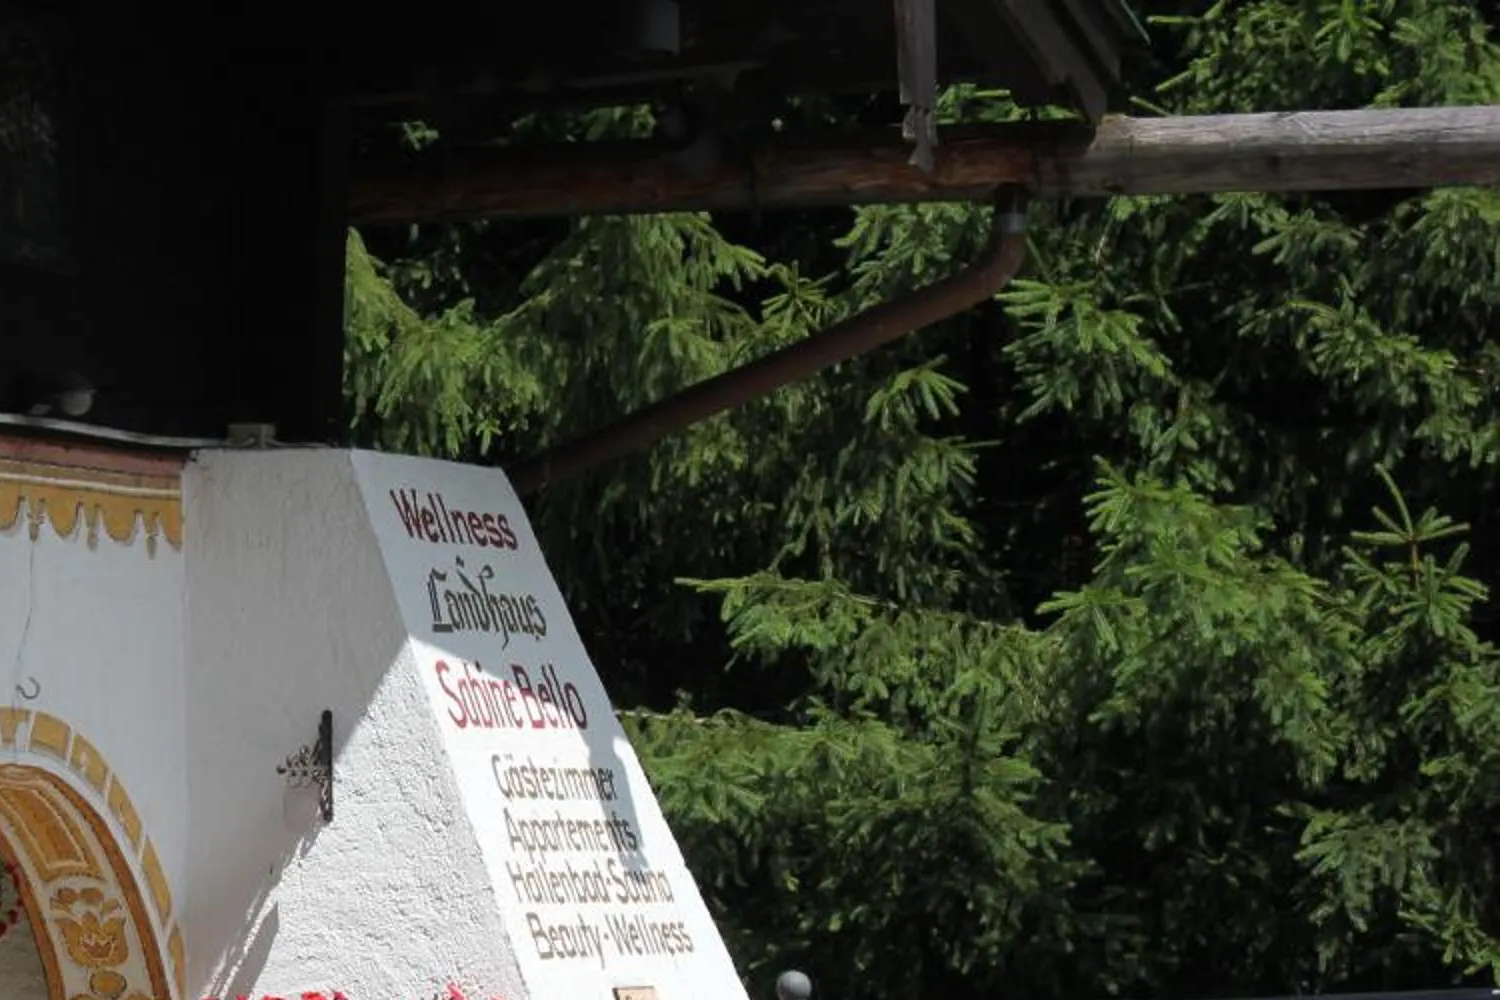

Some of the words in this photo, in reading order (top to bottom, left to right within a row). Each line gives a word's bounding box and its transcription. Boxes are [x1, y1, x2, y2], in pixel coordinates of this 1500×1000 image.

[389, 487, 518, 551] Wellness
[427, 555, 547, 650] Landhaus
[435, 660, 523, 730] Sabine
[511, 664, 588, 730] Bello
[491, 753, 618, 801] Gästezimmer
[503, 807, 638, 865] Appartements
